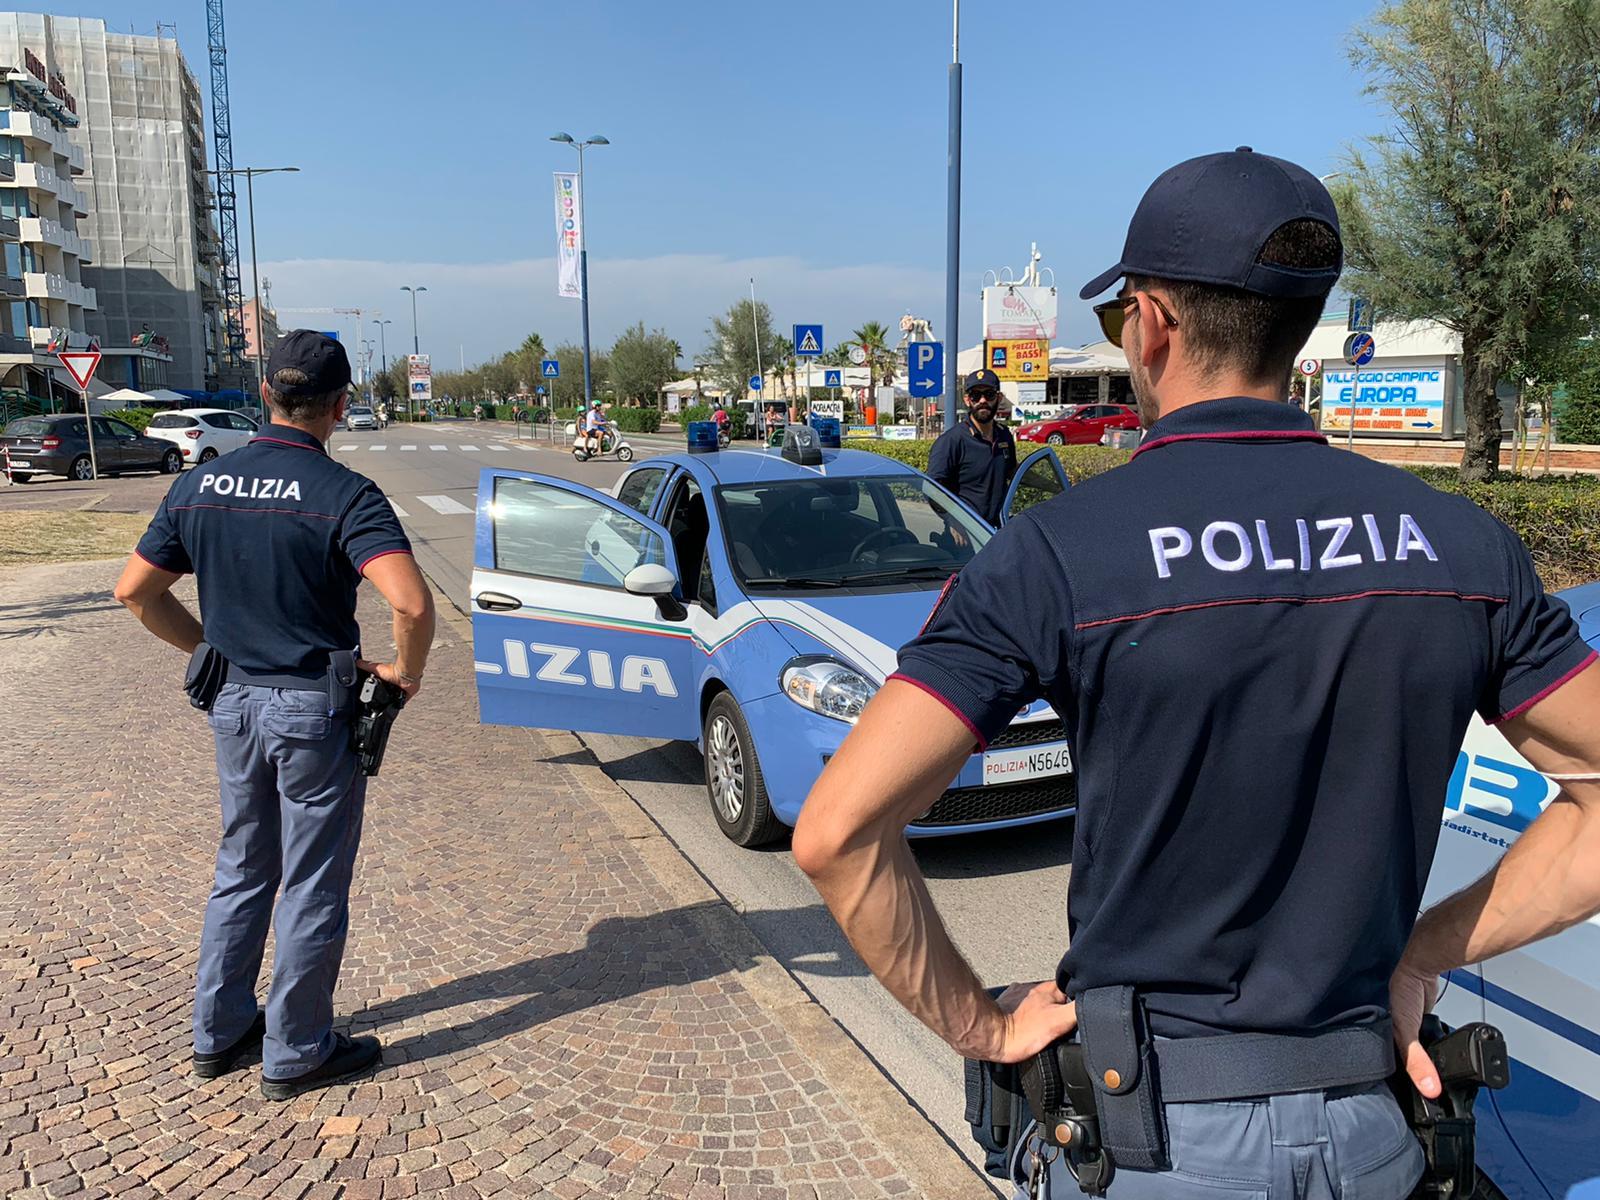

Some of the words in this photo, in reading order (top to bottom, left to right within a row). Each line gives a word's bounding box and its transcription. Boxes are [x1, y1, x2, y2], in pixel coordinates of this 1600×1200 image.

[1012, 341, 1036, 350] PREZZI
[918, 345, 934, 370] P
[1016, 349, 1042, 359] BASSI
[1024, 363, 1031, 372] P
[1306, 362, 1312, 371] 5
[1385, 371, 1439, 382] CAMPING
[1340, 387, 1416, 402] EUROPA
[199, 473, 302, 501] POLIZIA
[1148, 514, 1438, 579] POLIZIA
[986, 760, 1025, 775] POLIZIA
[1028, 749, 1069, 773] N5646
